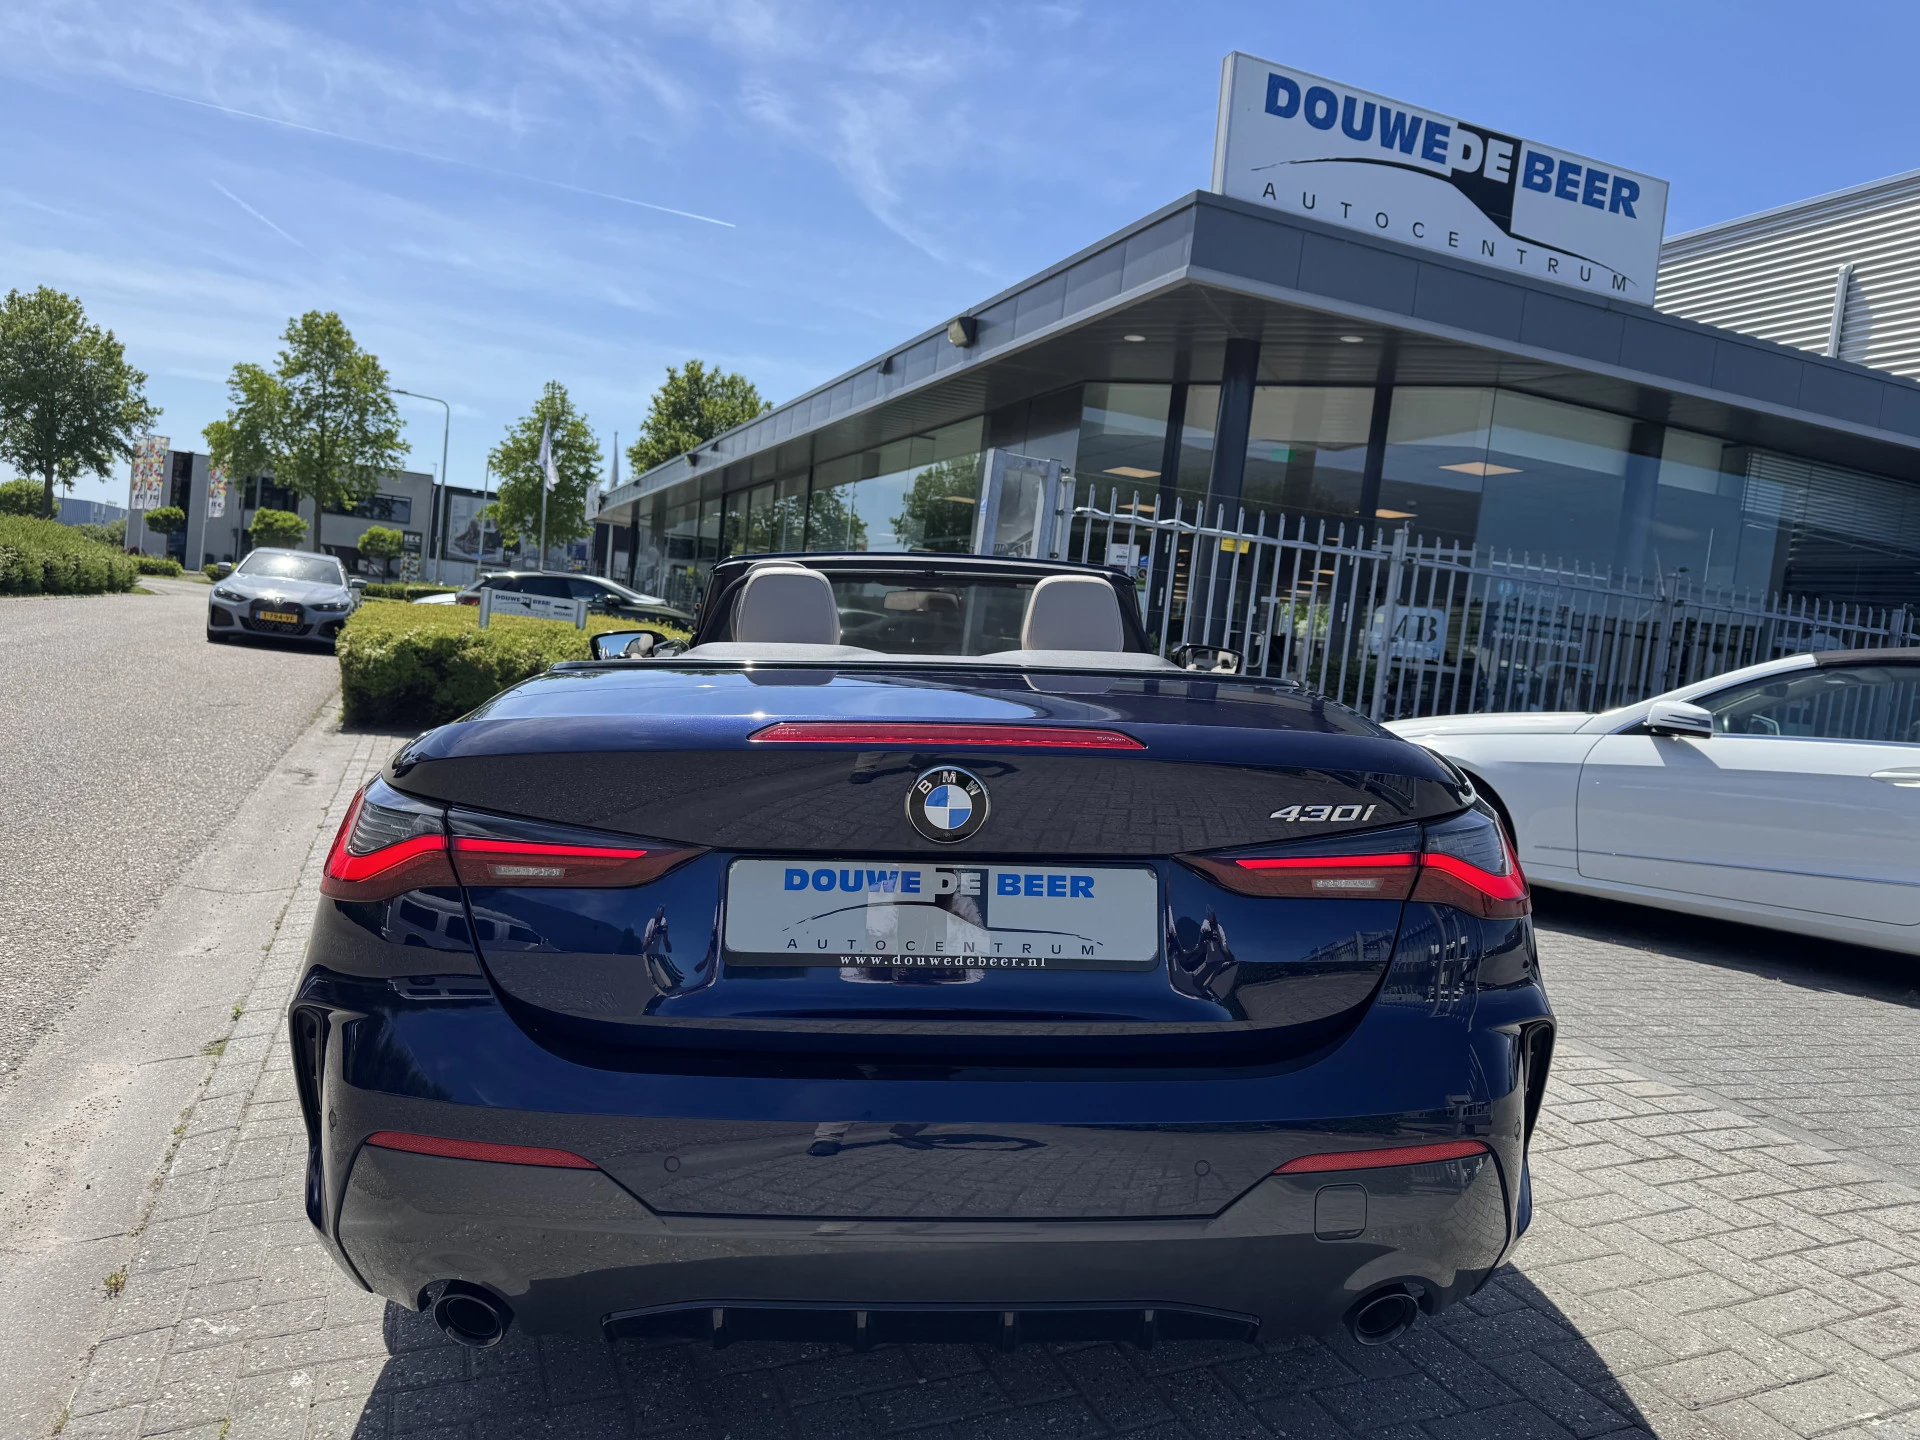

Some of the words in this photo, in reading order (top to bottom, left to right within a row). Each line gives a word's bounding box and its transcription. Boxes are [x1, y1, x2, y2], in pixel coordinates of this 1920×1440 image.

[1264, 72, 1451, 166] DOUWE
[1450, 125, 1514, 184] DE
[1521, 150, 1641, 220] BEER
[1262, 182, 1627, 292] AUTOCENTRUM
[917, 770, 982, 797] BMW
[784, 868, 921, 894] DOUWE
[935, 871, 981, 896] DE
[996, 873, 1095, 899] BEER
[786, 938, 1096, 957] AUTOCENTRUM
[839, 954, 1047, 968] www.douwedebeer.nl
